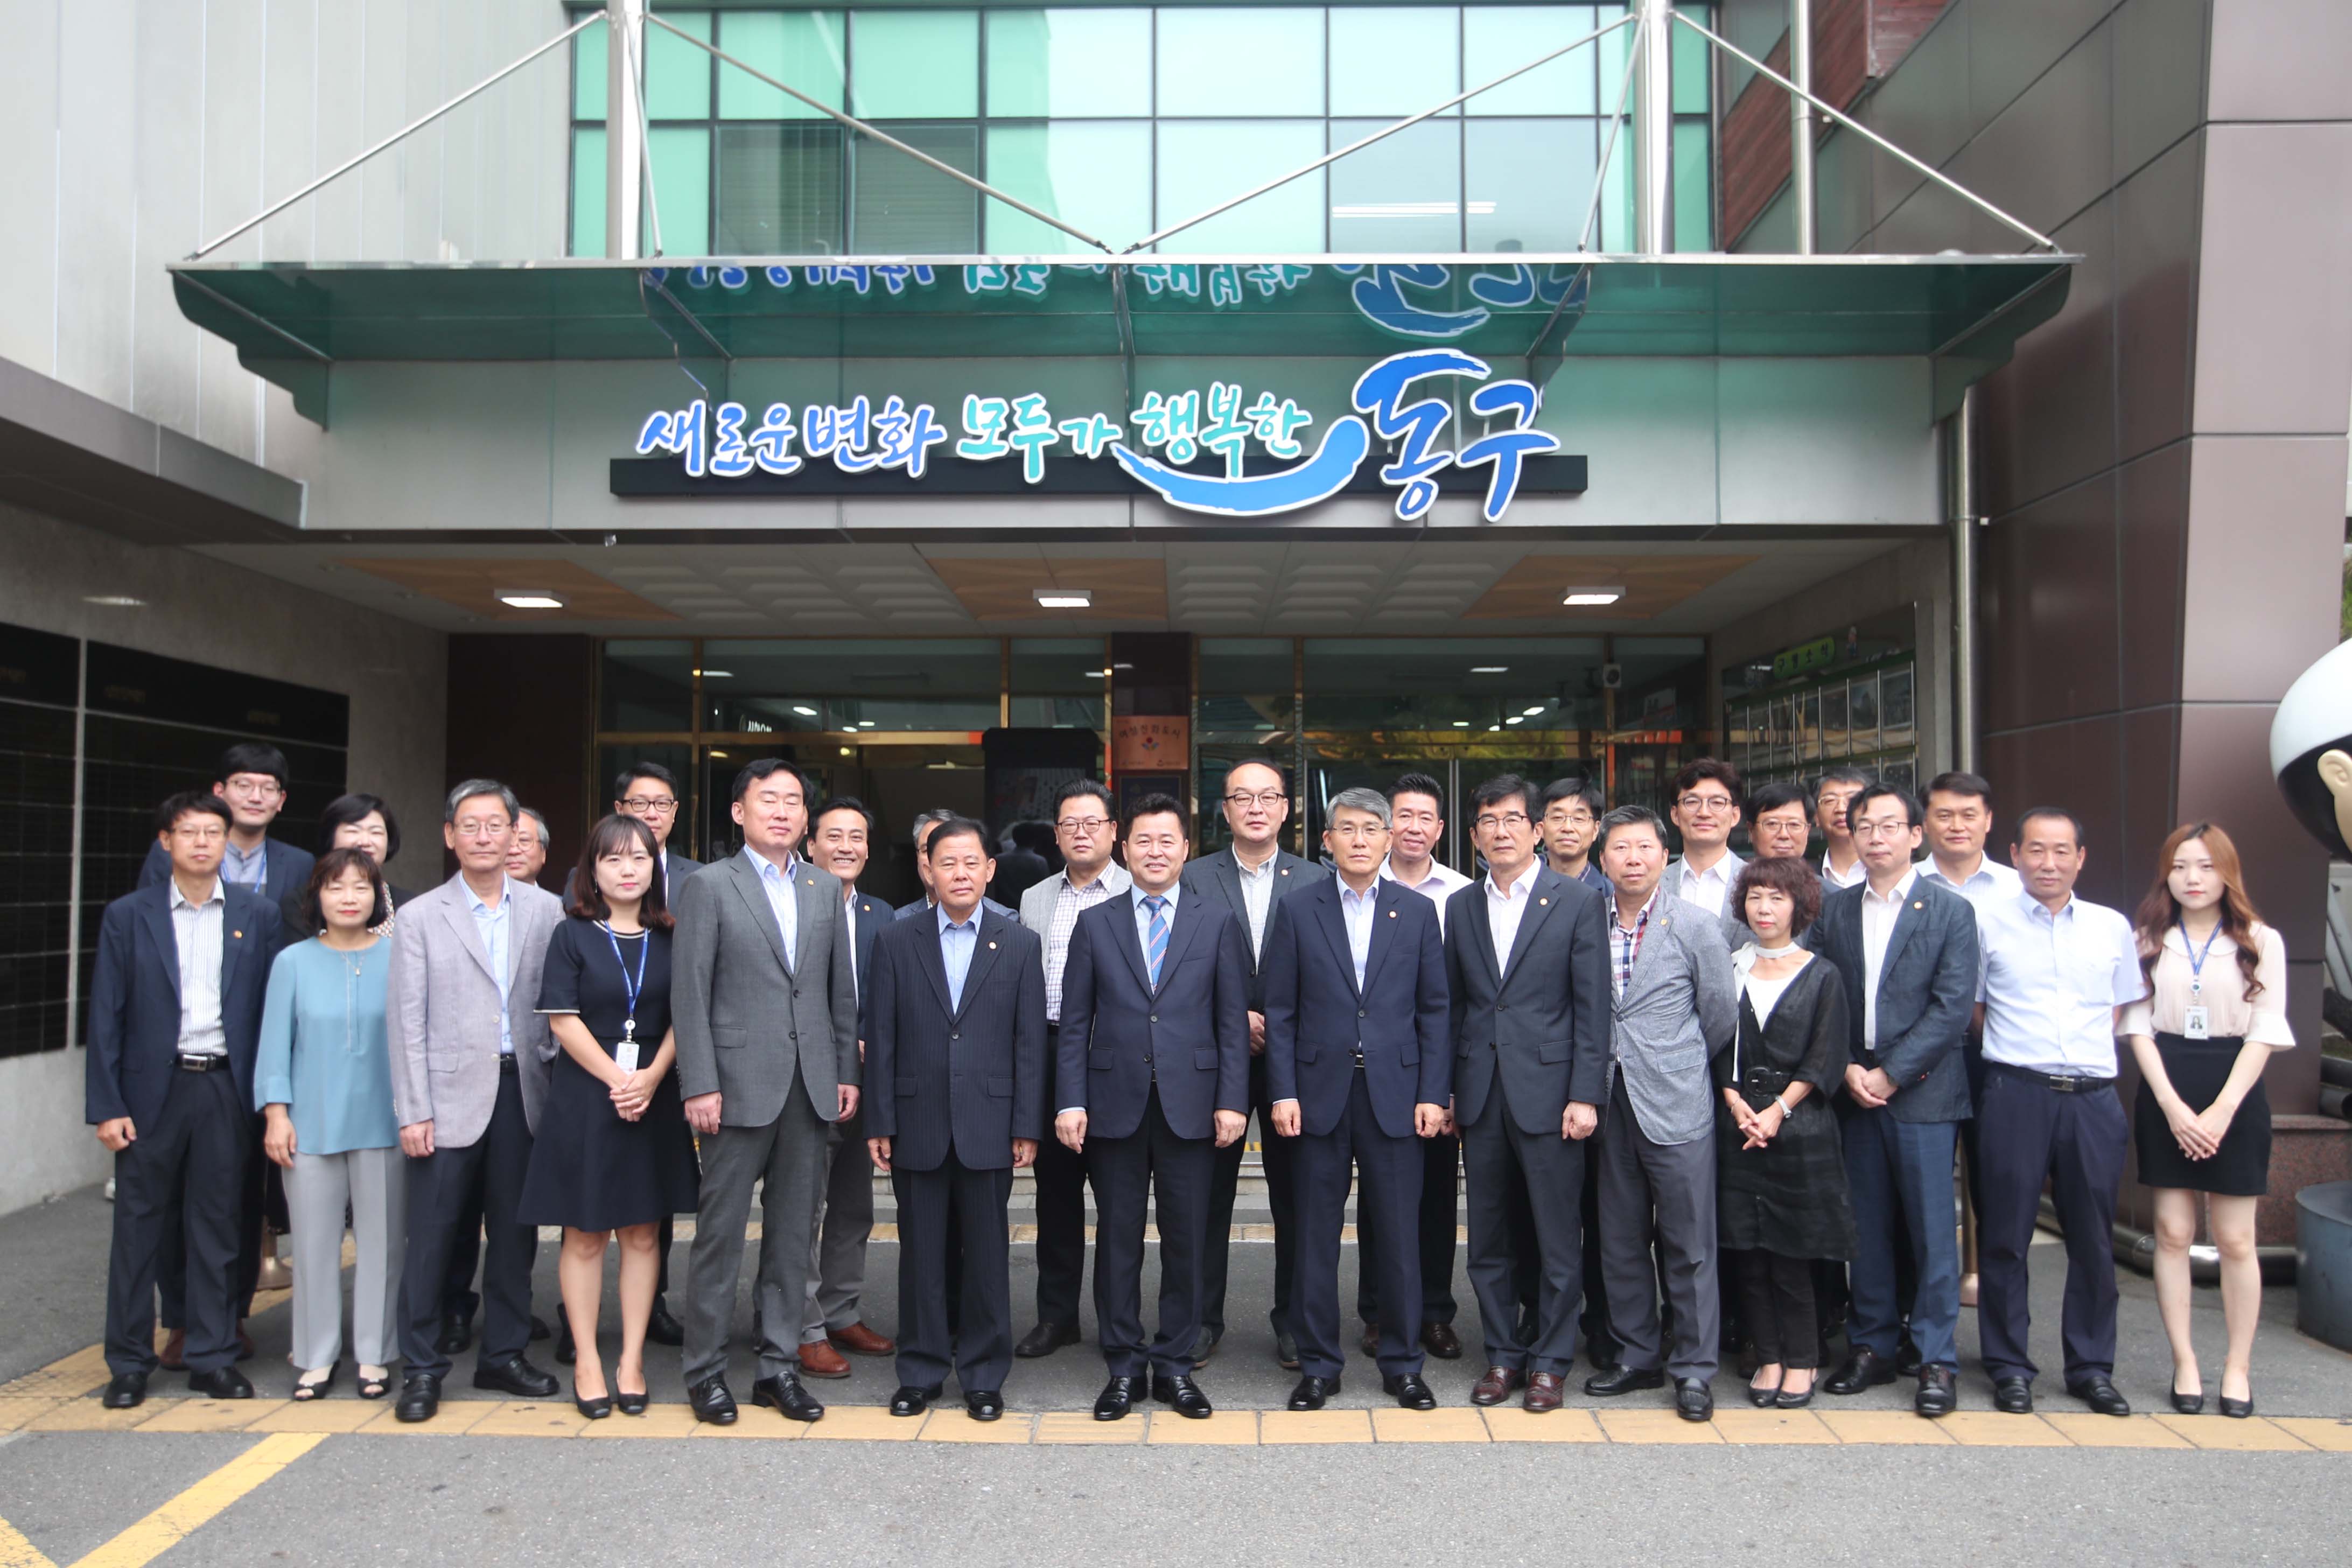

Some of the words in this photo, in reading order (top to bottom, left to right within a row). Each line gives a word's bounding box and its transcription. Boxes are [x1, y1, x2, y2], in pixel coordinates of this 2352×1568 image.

[636, 400, 801, 477] 새로운
[803, 395, 947, 478] 변화
[956, 393, 1122, 484] 모두가
[1131, 381, 1312, 479] 행복한
[1352, 348, 1560, 522] 동구
